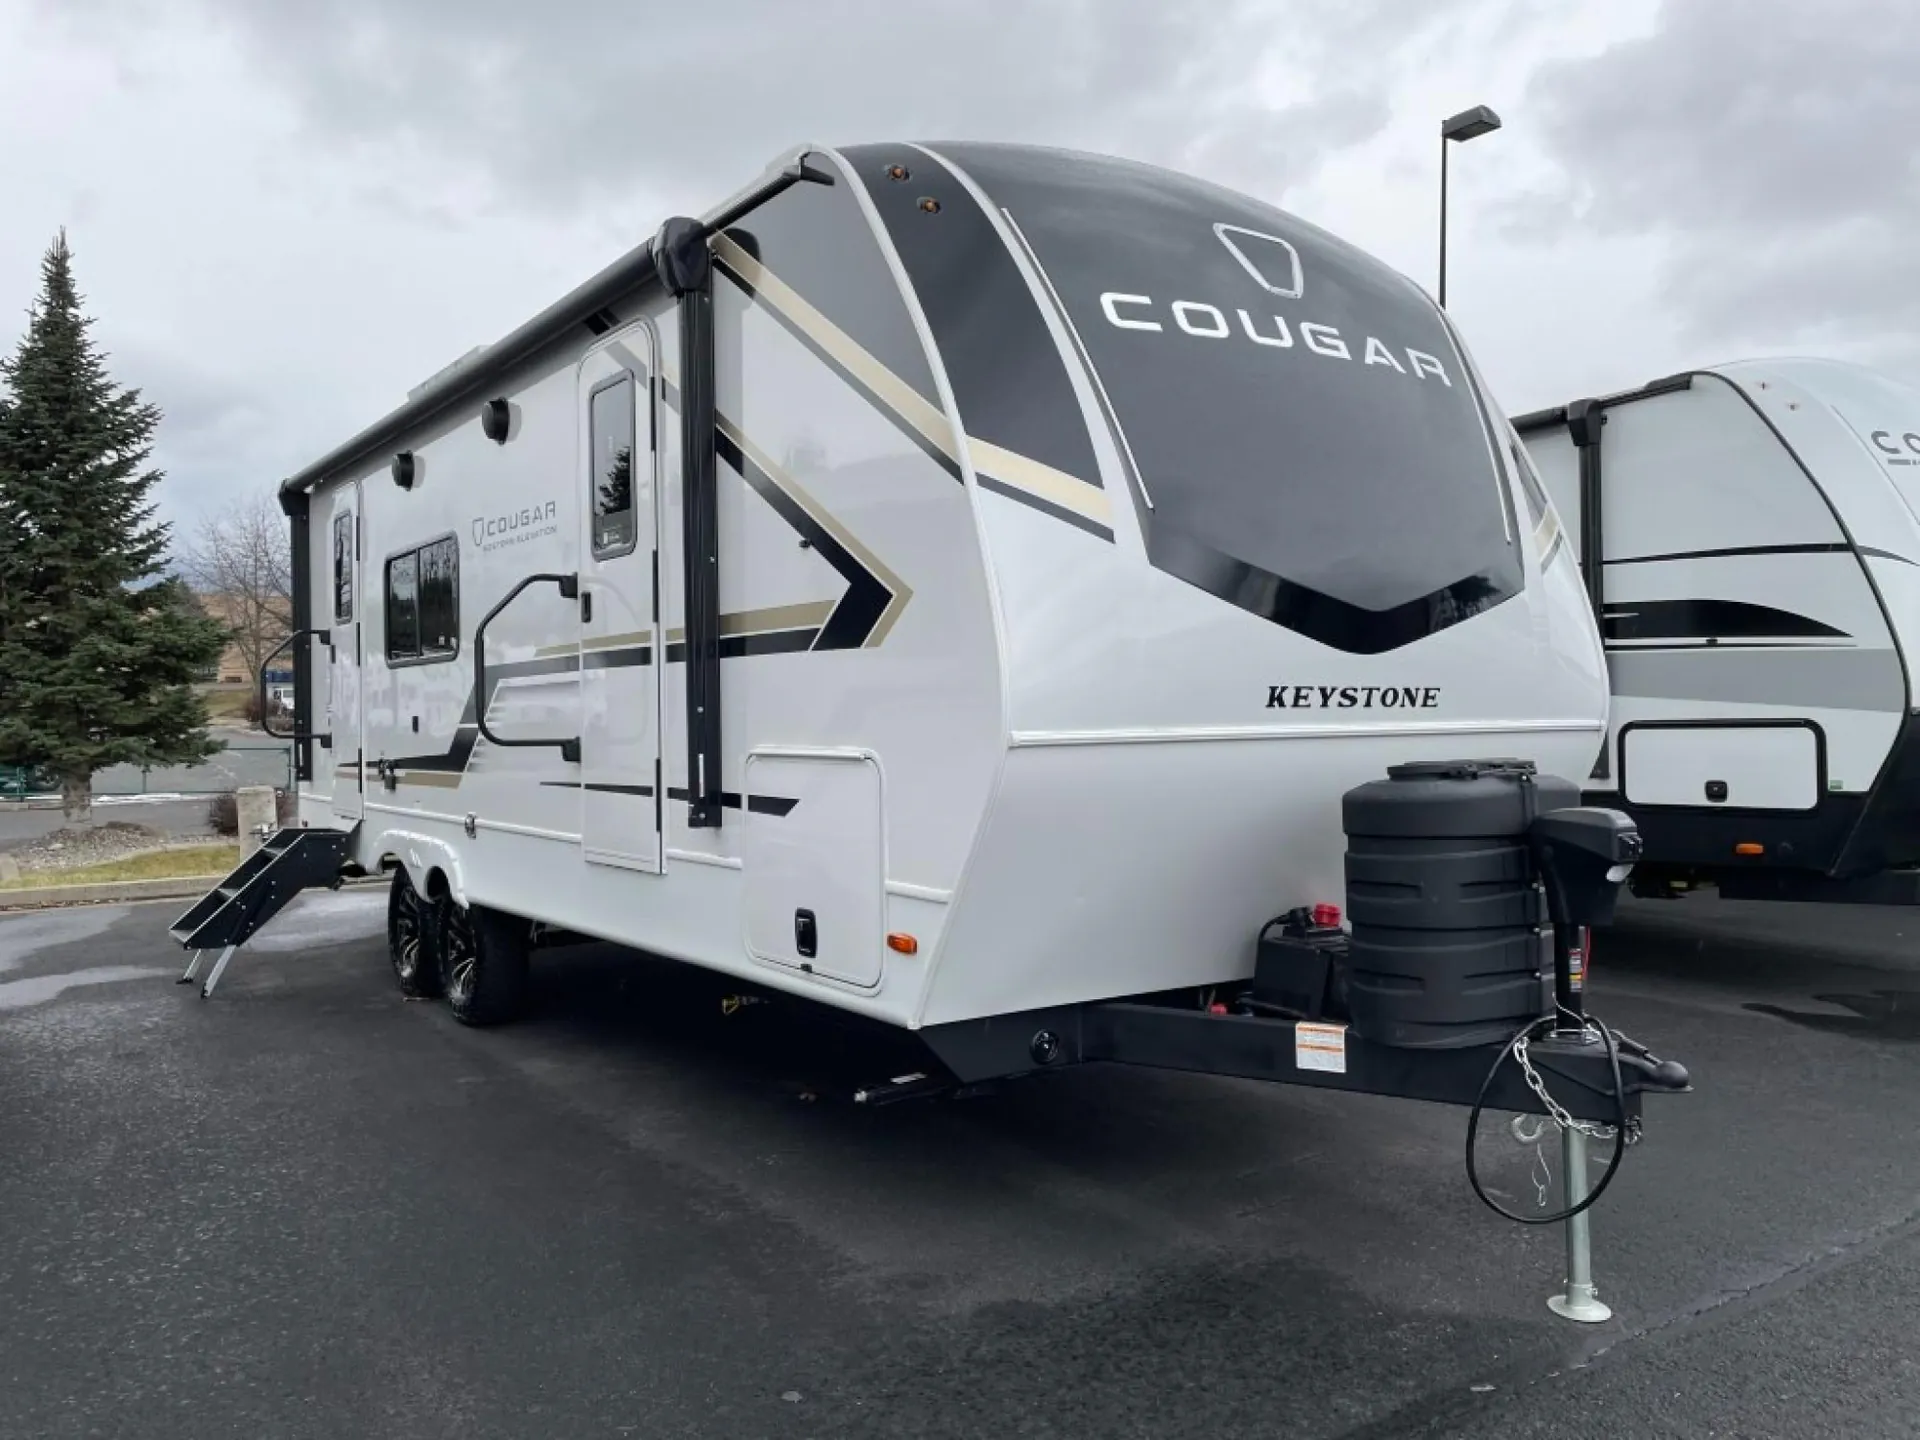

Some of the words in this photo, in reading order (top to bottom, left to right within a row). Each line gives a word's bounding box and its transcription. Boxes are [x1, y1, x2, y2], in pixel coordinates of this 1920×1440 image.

[1100, 291, 1453, 387] COUGAR
[487, 500, 556, 537] COUGAR
[1265, 685, 1441, 708] KEYSTONE
